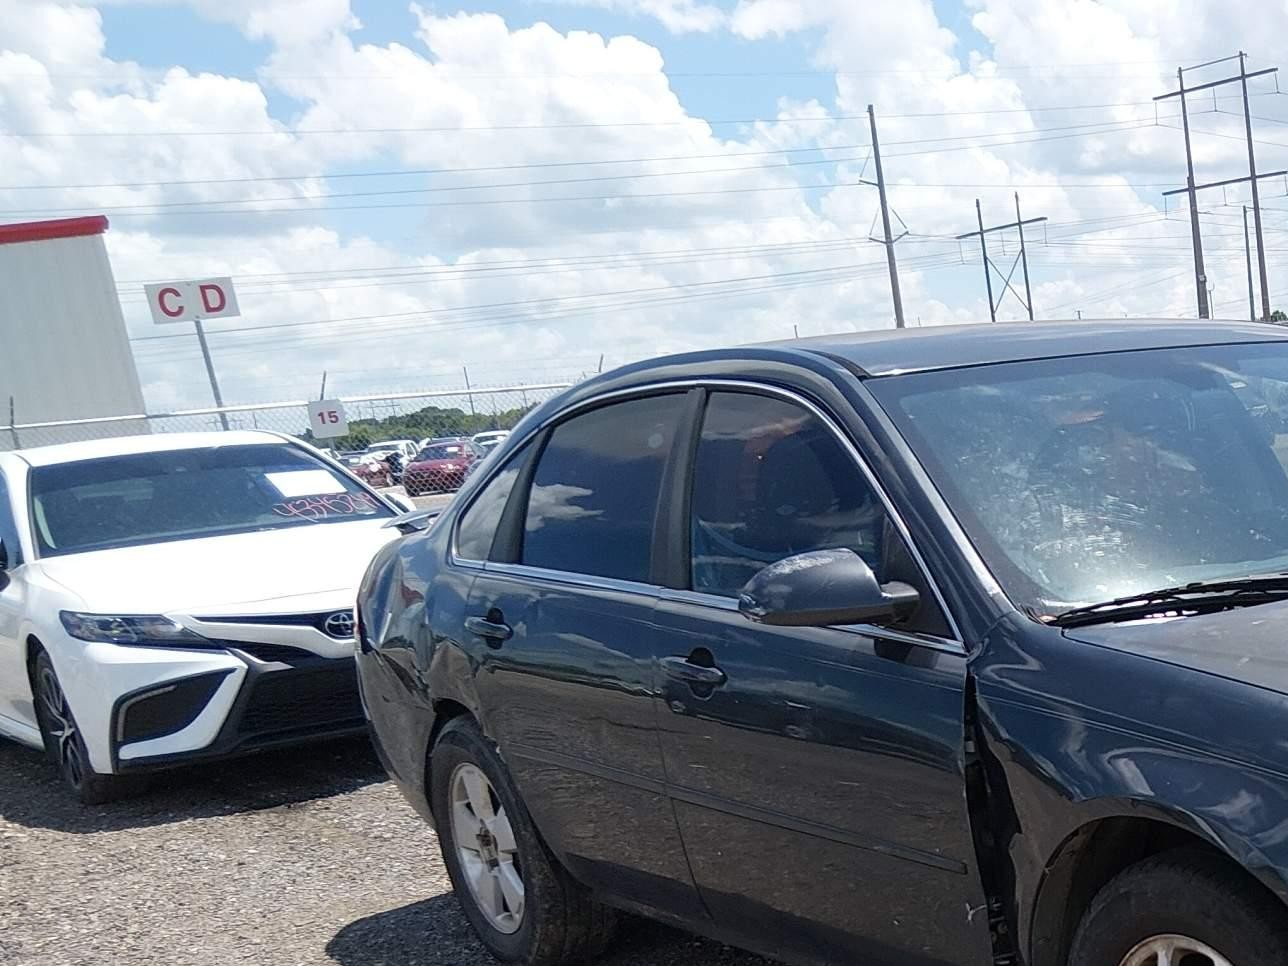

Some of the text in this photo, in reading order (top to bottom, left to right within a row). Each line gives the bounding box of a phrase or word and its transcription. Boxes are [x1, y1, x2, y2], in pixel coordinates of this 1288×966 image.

[158, 284, 226, 317] C D
[317, 410, 340, 425] 15
